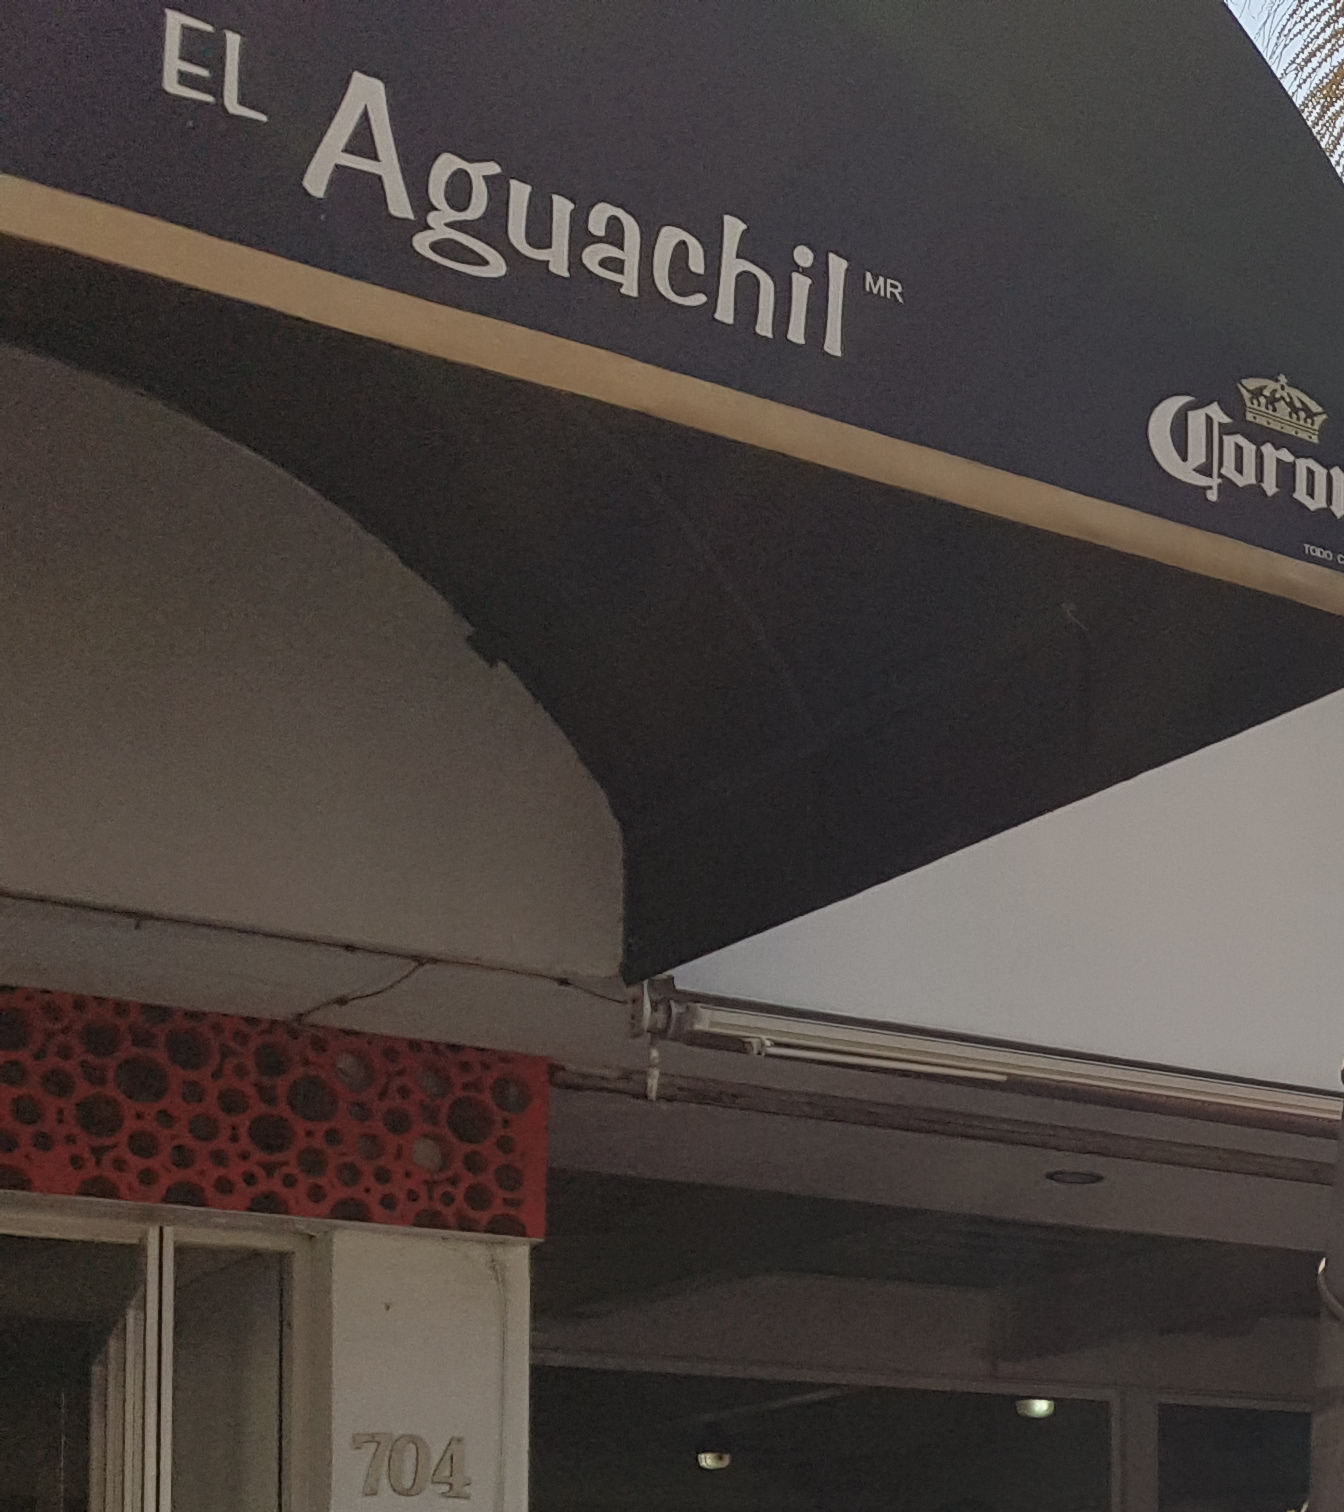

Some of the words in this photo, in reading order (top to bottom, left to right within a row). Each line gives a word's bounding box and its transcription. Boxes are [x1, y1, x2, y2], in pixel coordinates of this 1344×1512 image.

[161, 7, 268, 123] EL
[301, 69, 849, 358] Aguachil
[865, 270, 905, 305] MR
[1303, 543, 1333, 561] TODO
[351, 1431, 473, 1500] 704
